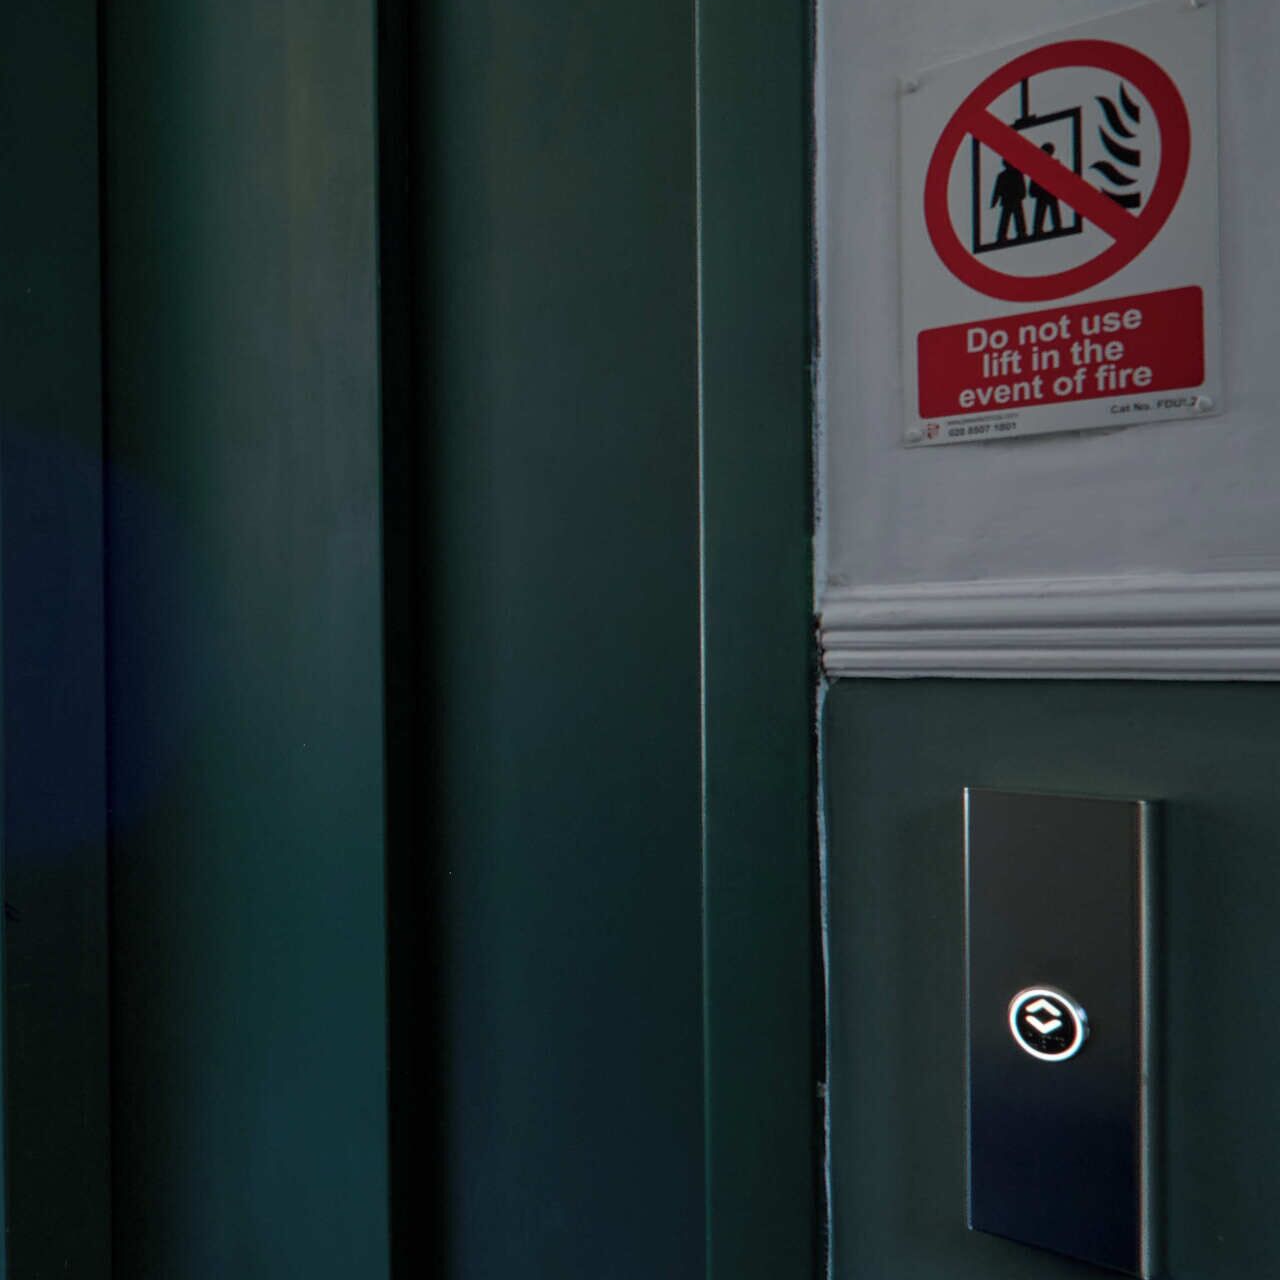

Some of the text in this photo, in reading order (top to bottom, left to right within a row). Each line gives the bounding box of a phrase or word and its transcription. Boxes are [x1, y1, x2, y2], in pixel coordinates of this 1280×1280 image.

[967, 308, 1142, 353] Do not use
[982, 338, 1124, 378] lift in the
[958, 364, 1153, 408] event of fire
